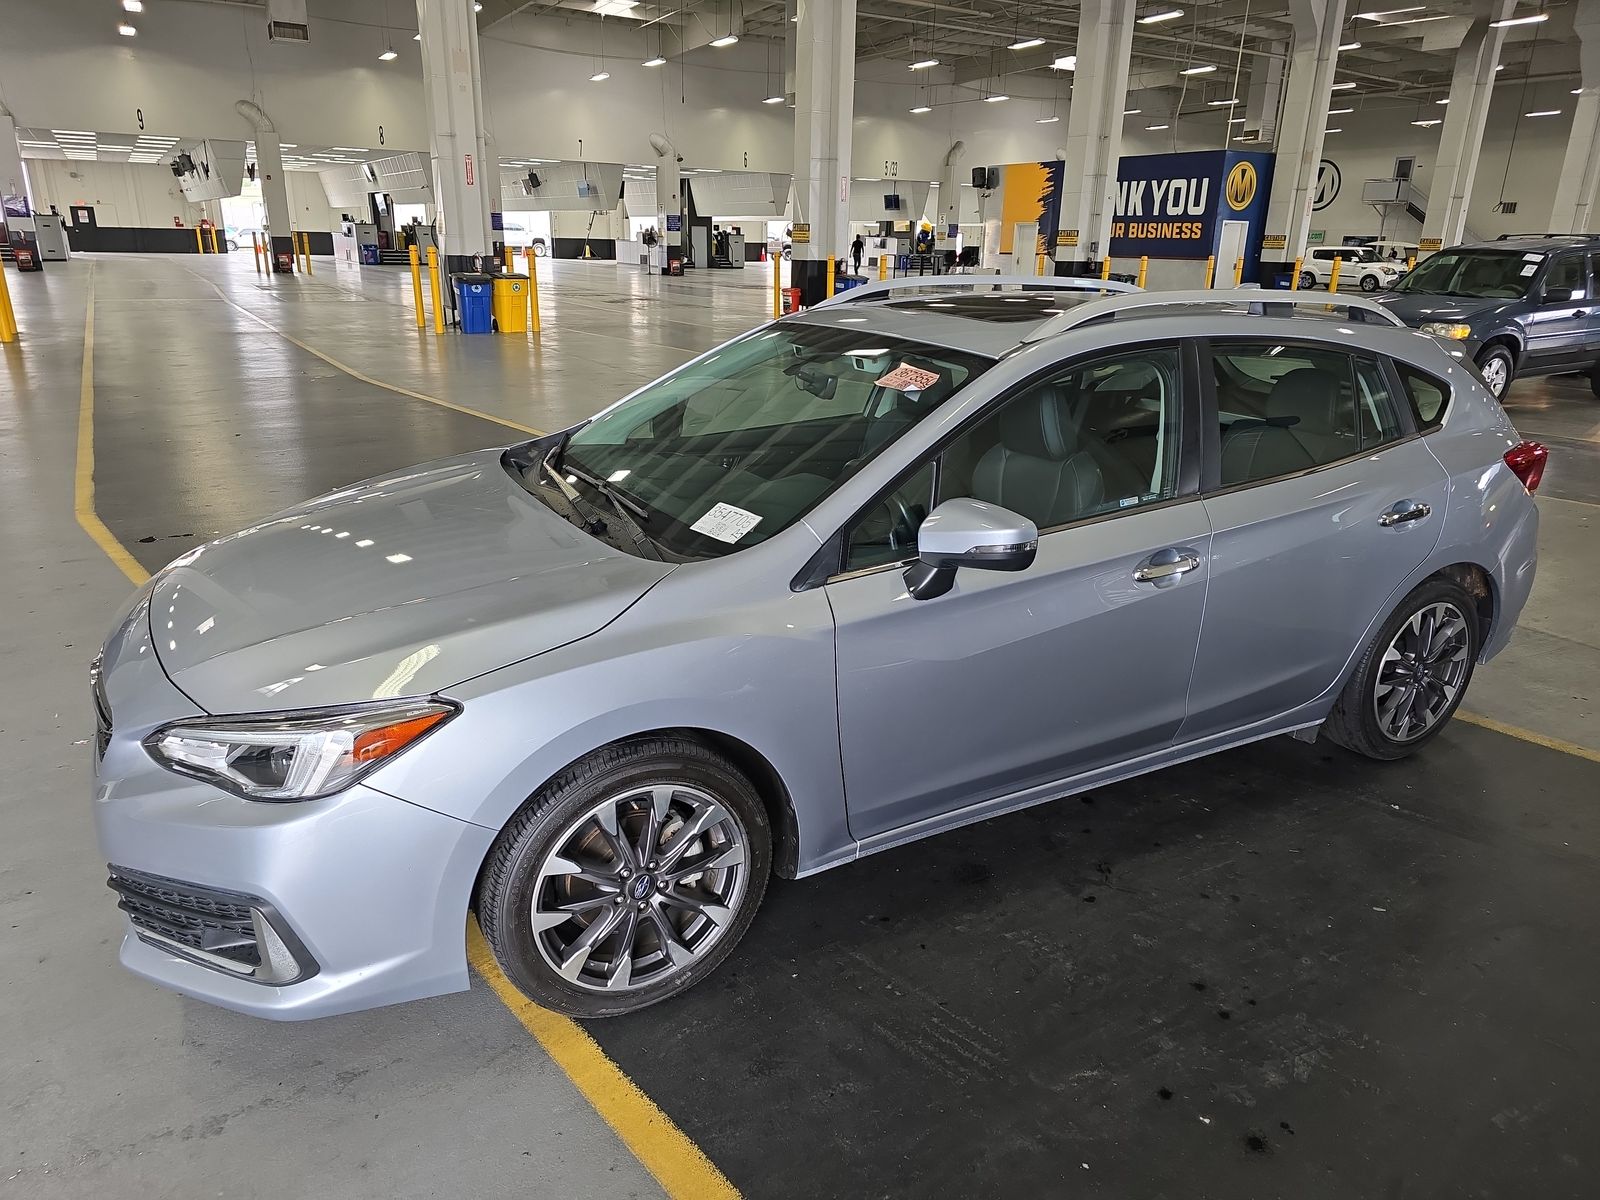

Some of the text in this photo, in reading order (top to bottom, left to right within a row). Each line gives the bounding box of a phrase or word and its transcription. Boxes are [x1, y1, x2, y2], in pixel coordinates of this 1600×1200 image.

[136, 108, 145, 131] 9
[378, 125, 385, 146] 8
[577, 139, 583, 158] 7
[743, 151, 748, 168] 6
[1151, 178, 1209, 215] YOU
[1128, 222, 1202, 239] BUSINESS
[708, 505, 756, 529] 3547705
